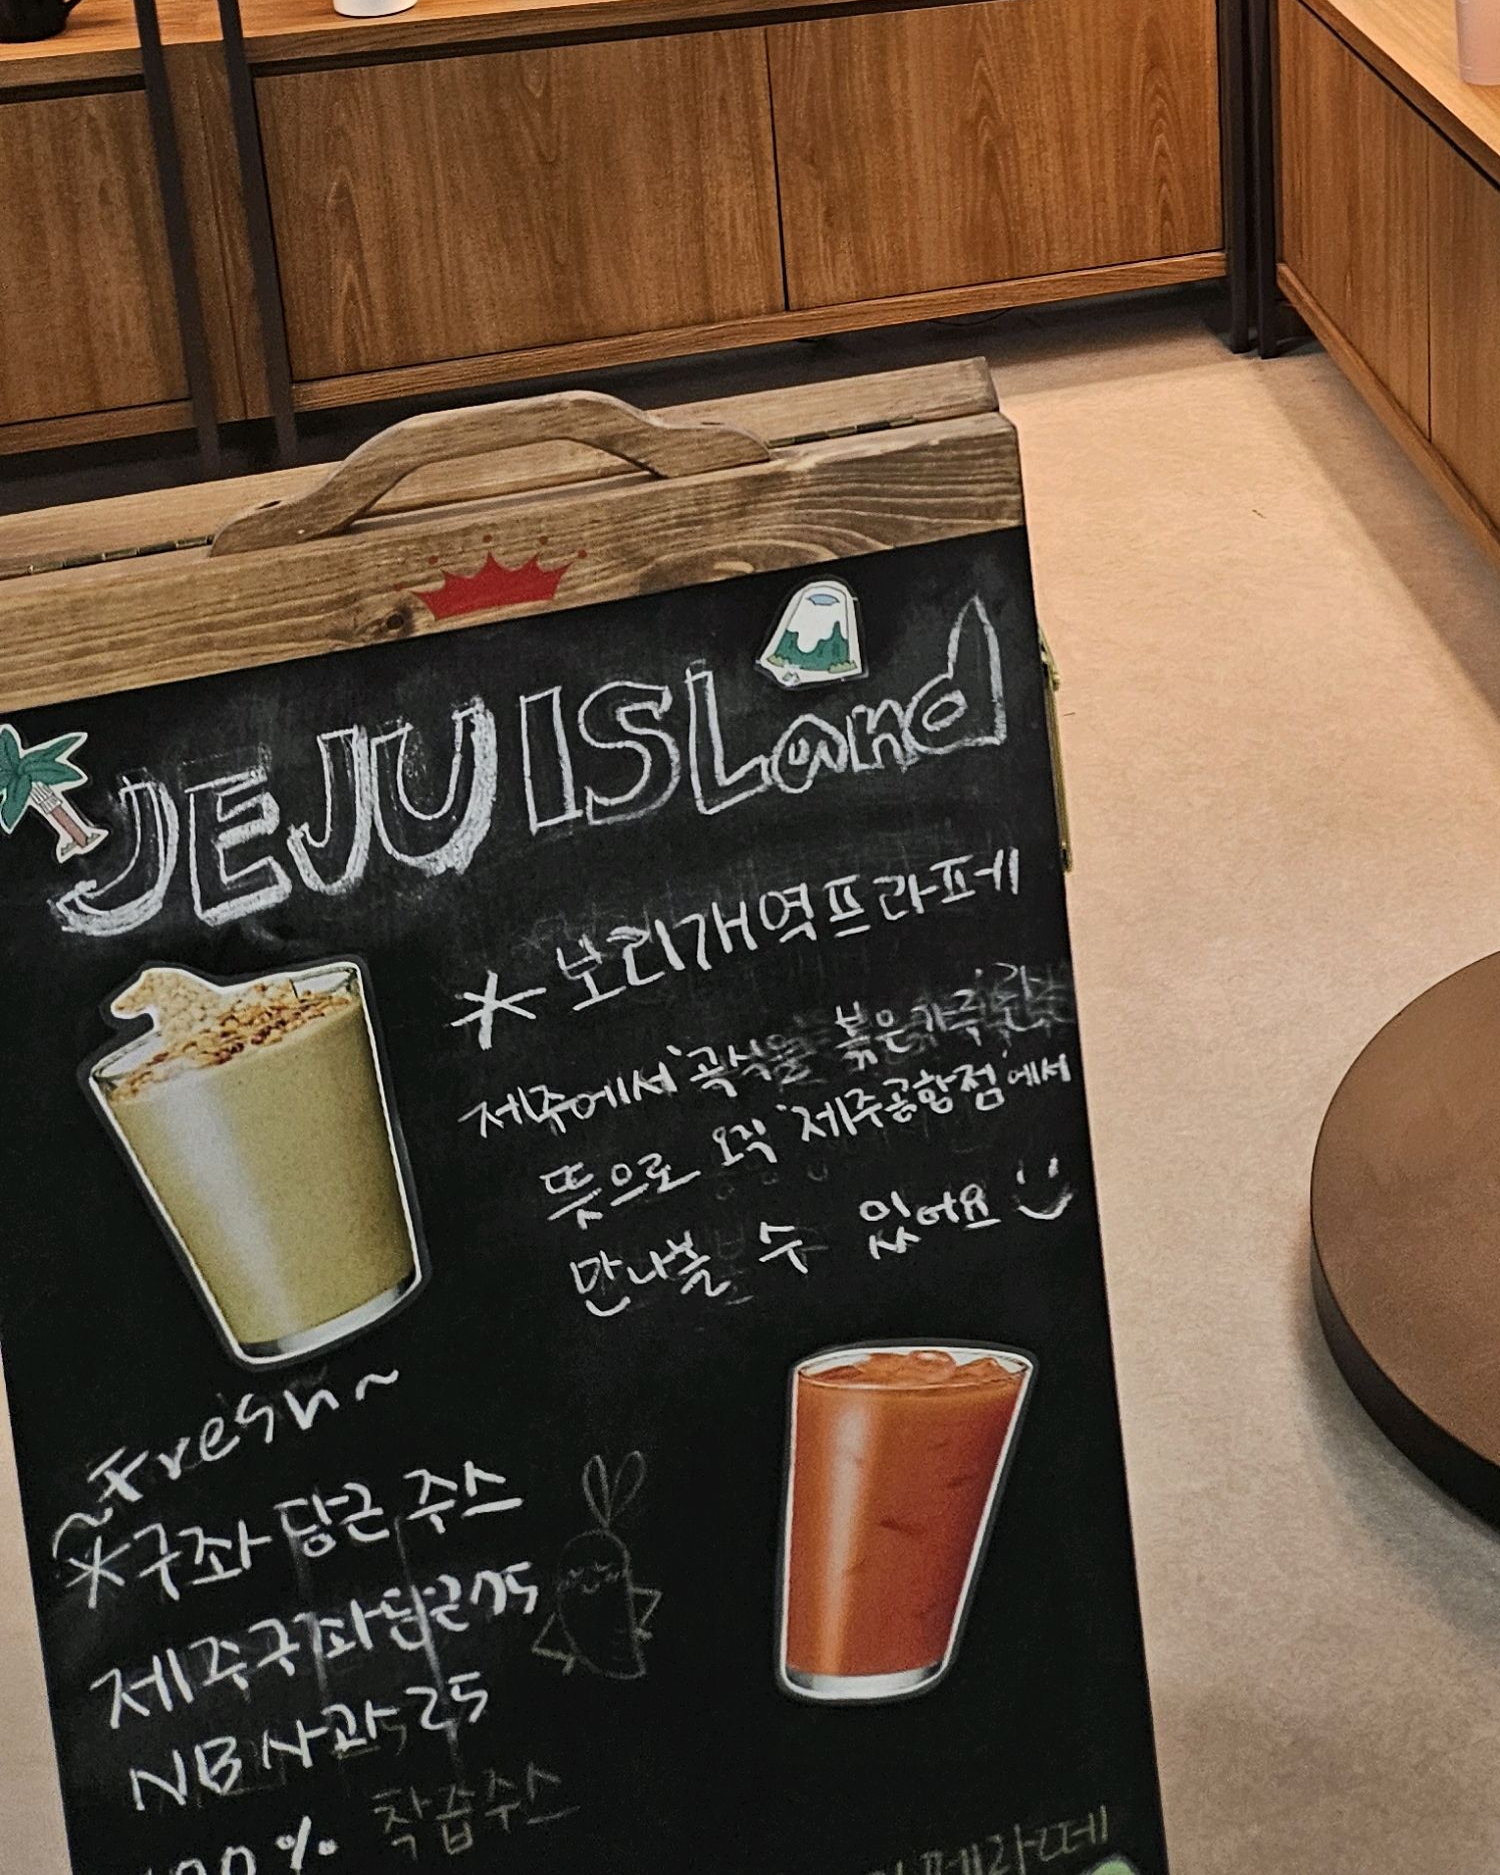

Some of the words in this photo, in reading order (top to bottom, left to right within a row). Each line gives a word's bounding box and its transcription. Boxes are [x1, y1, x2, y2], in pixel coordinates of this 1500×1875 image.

[48, 695, 498, 937] JEJU
[457, 1061, 678, 1138] 제주에서
[540, 1153, 700, 1230] 뜻으로
[712, 1117, 778, 1167] 오직
[569, 1229, 731, 1318] 만나볼
[758, 1221, 810, 1275] 수
[859, 1183, 1002, 1261] 있어요
[404, 1461, 523, 1534] 주스
